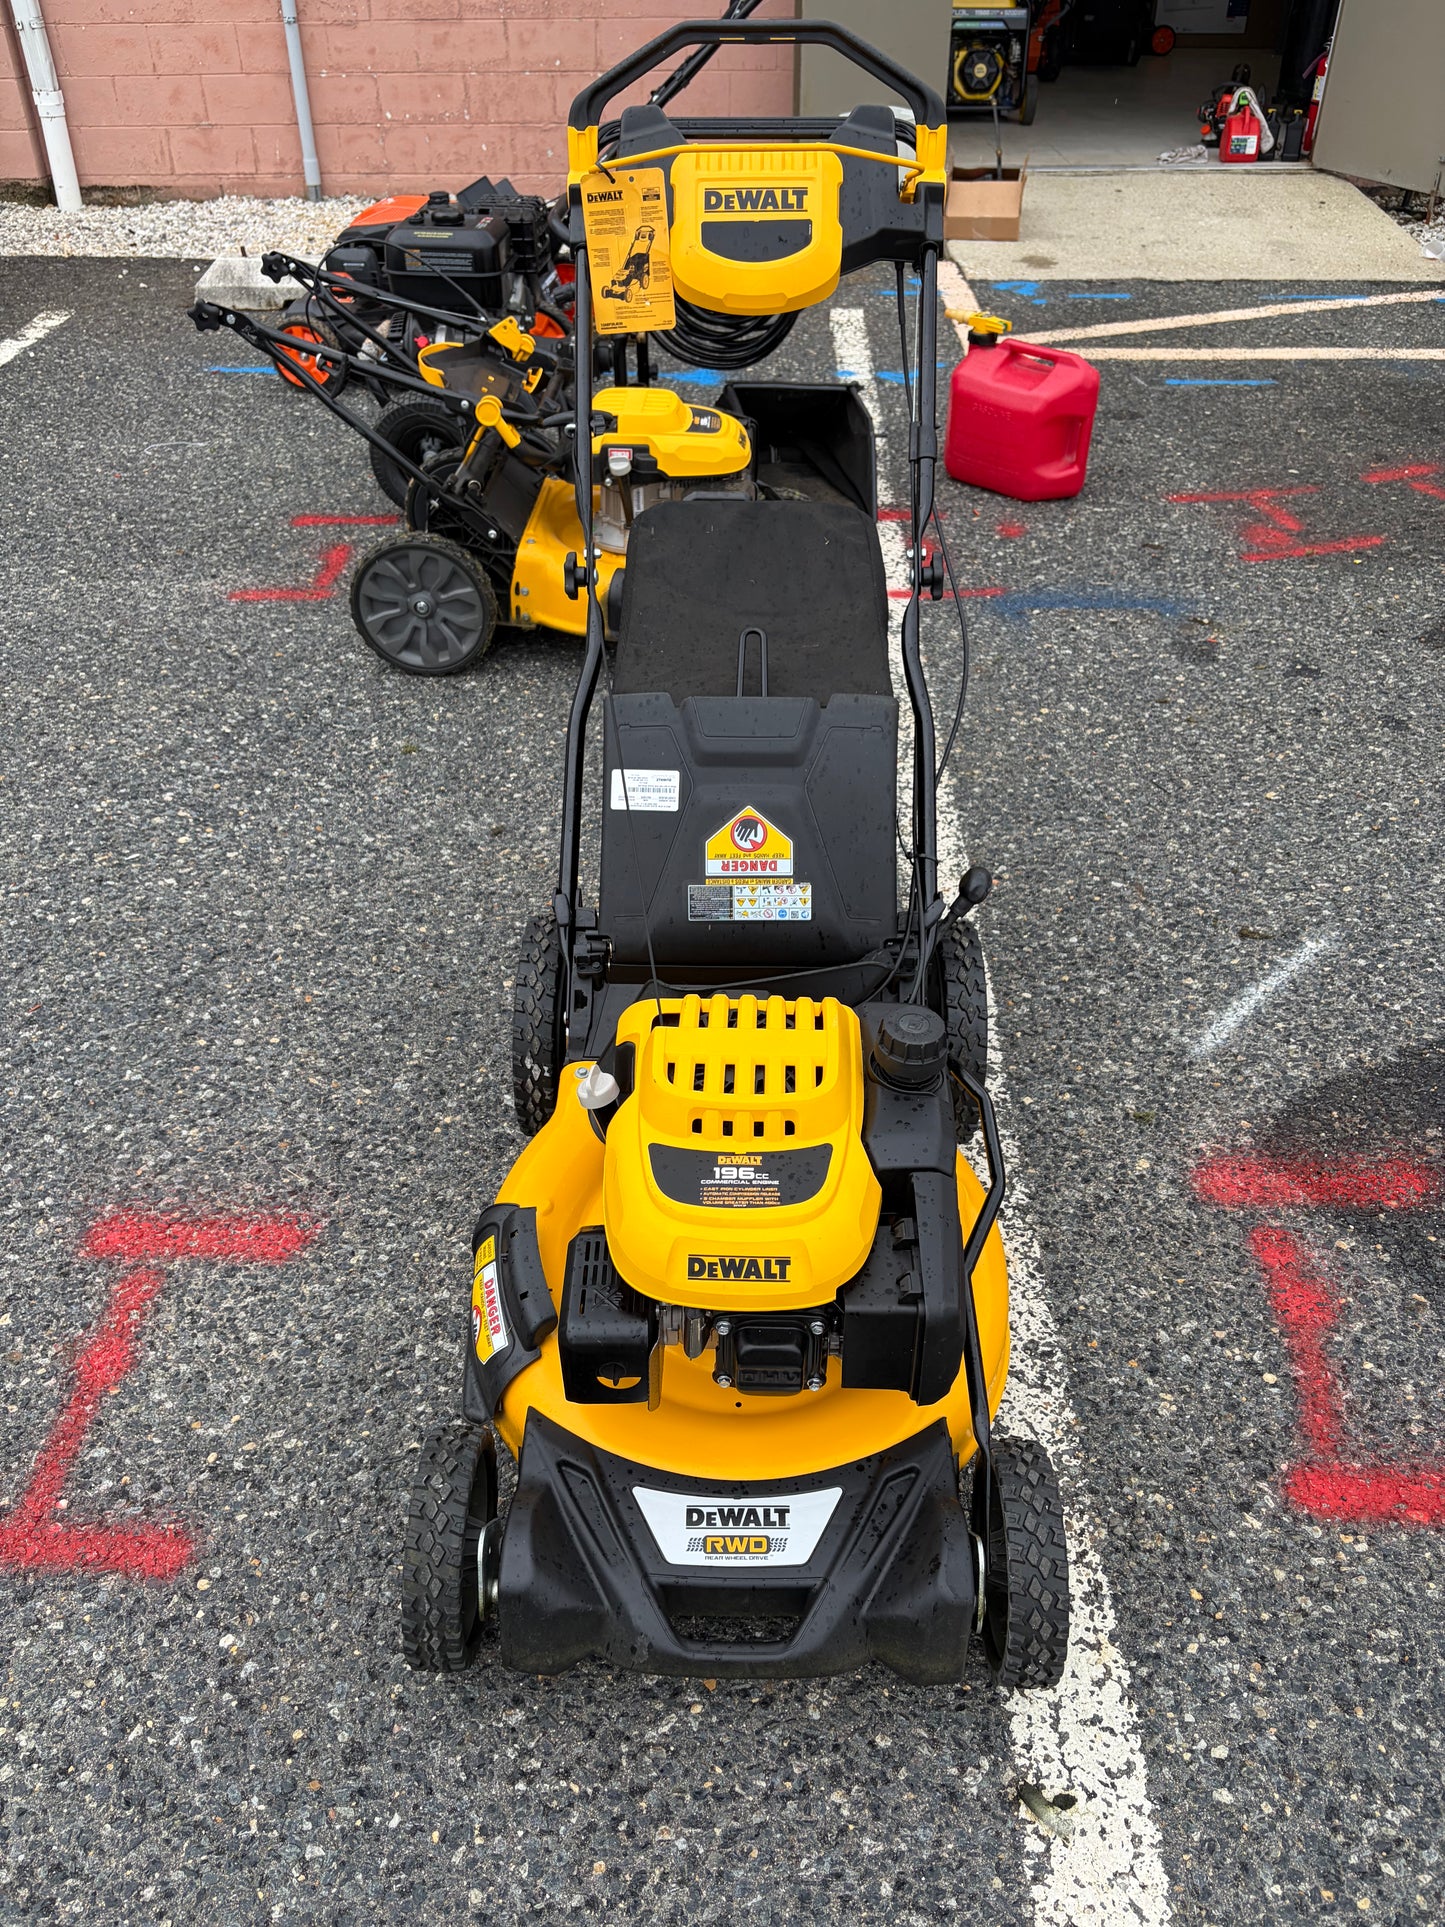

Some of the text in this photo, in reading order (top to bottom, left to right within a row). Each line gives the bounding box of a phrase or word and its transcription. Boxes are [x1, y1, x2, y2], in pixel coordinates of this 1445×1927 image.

[721, 860, 778, 872] DANGER
[713, 1167, 769, 1179] 196cc
[484, 1278, 502, 1336] DANGER
[706, 1537, 768, 1553] RWD
